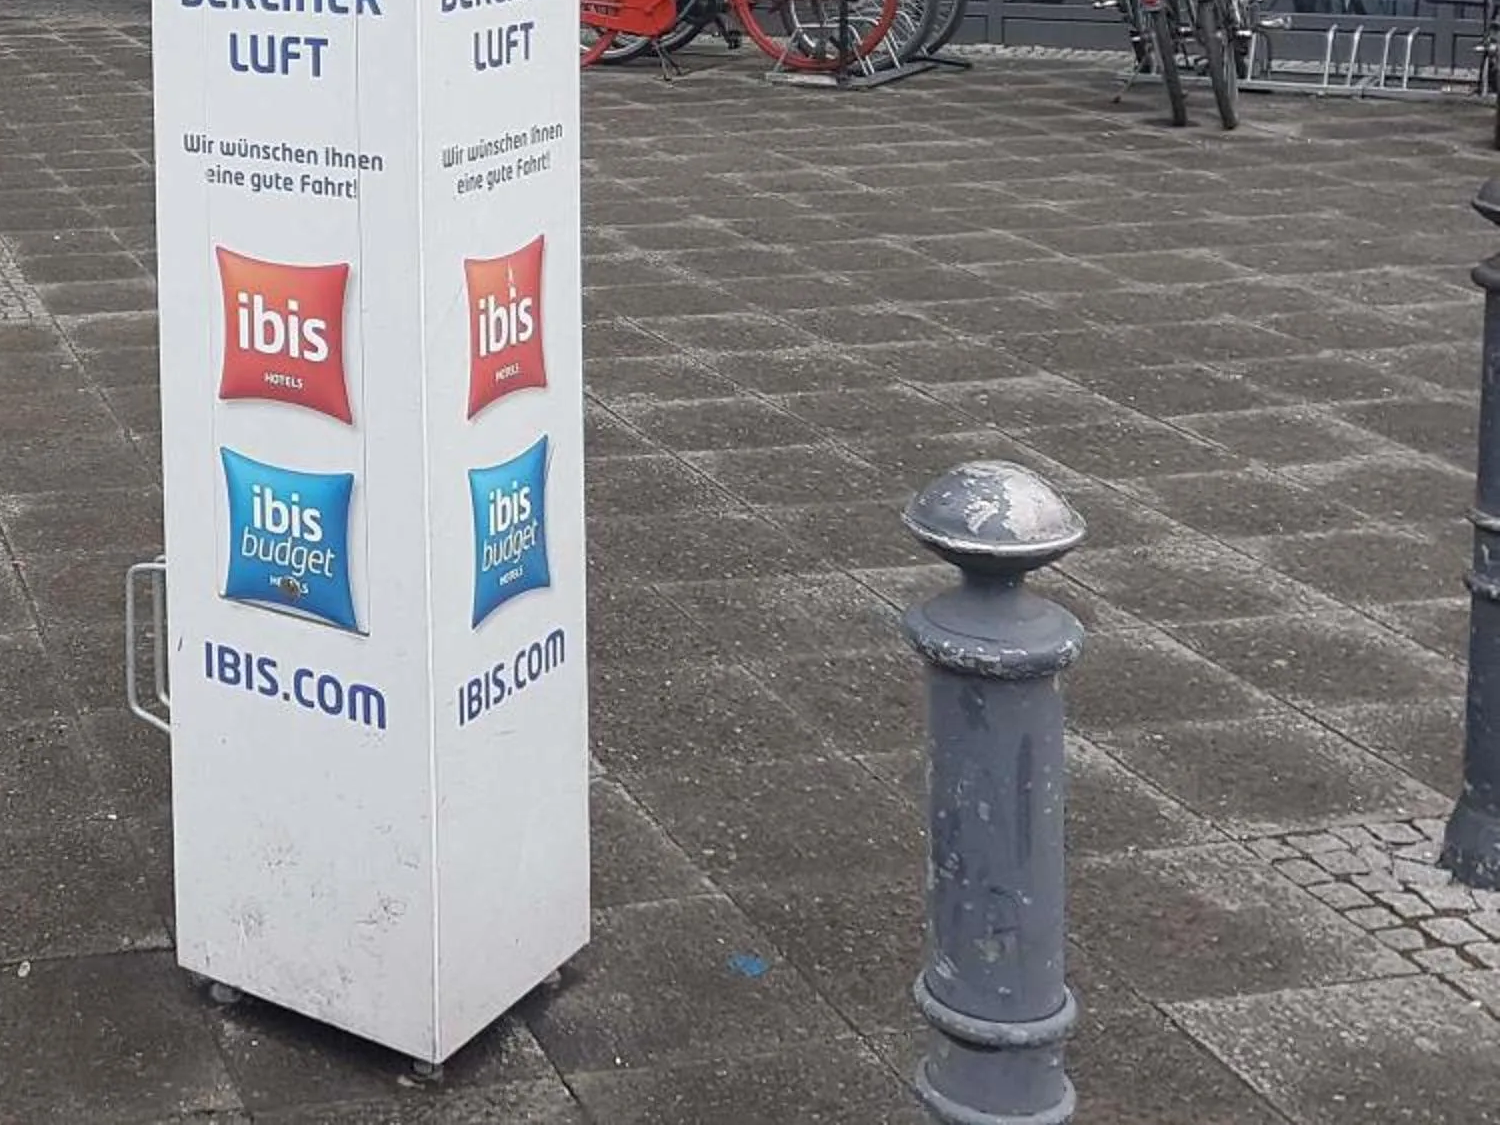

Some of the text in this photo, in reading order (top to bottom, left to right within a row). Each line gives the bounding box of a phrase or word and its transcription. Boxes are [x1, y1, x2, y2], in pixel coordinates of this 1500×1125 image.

[229, 32, 329, 78] LUFT
[474, 21, 534, 71] LUFT
[184, 133, 384, 172] Wir wünschen Ihnen
[442, 123, 563, 167] Wir wünschen Ihnen
[206, 165, 358, 199] eine gute Fahrt!
[457, 150, 551, 194] eine gute Fahrt!
[237, 292, 330, 363] ibis
[478, 288, 534, 358] ibis
[263, 371, 304, 390] HOTELS
[252, 484, 324, 543] ibis
[488, 479, 531, 536] ibis
[241, 525, 336, 578] budget
[481, 517, 539, 572] budget
